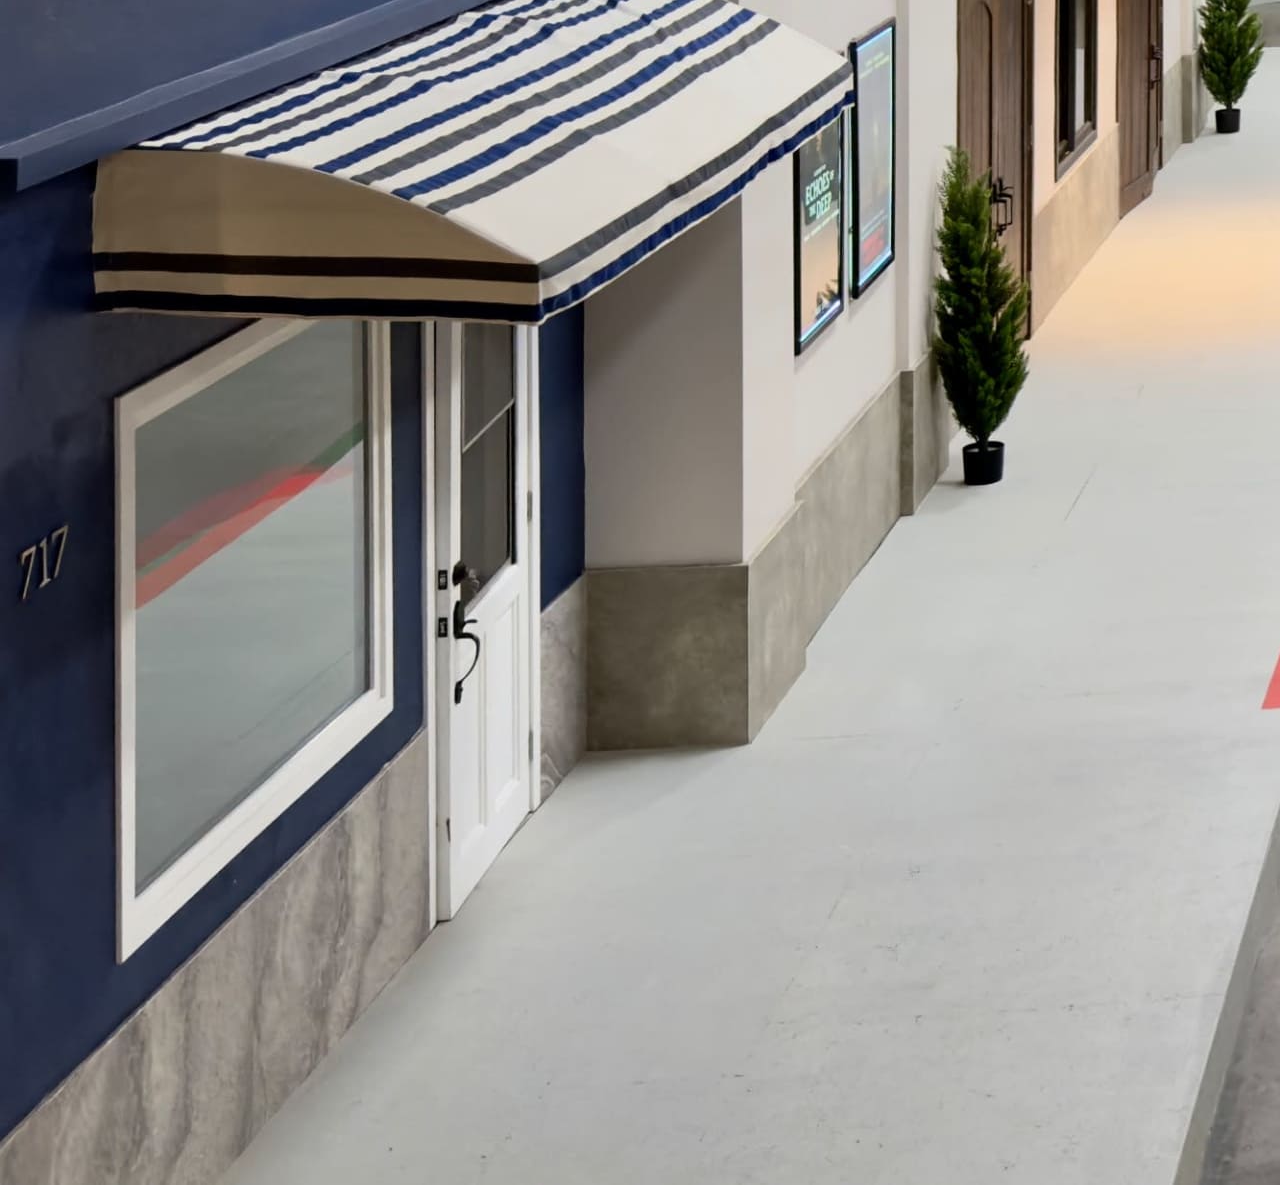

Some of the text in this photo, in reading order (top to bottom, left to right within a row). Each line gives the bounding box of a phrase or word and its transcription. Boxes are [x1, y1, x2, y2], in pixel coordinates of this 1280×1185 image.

[805, 170, 830, 207] ECHOES
[816, 191, 832, 220] DEEP
[20, 524, 69, 600] 717
